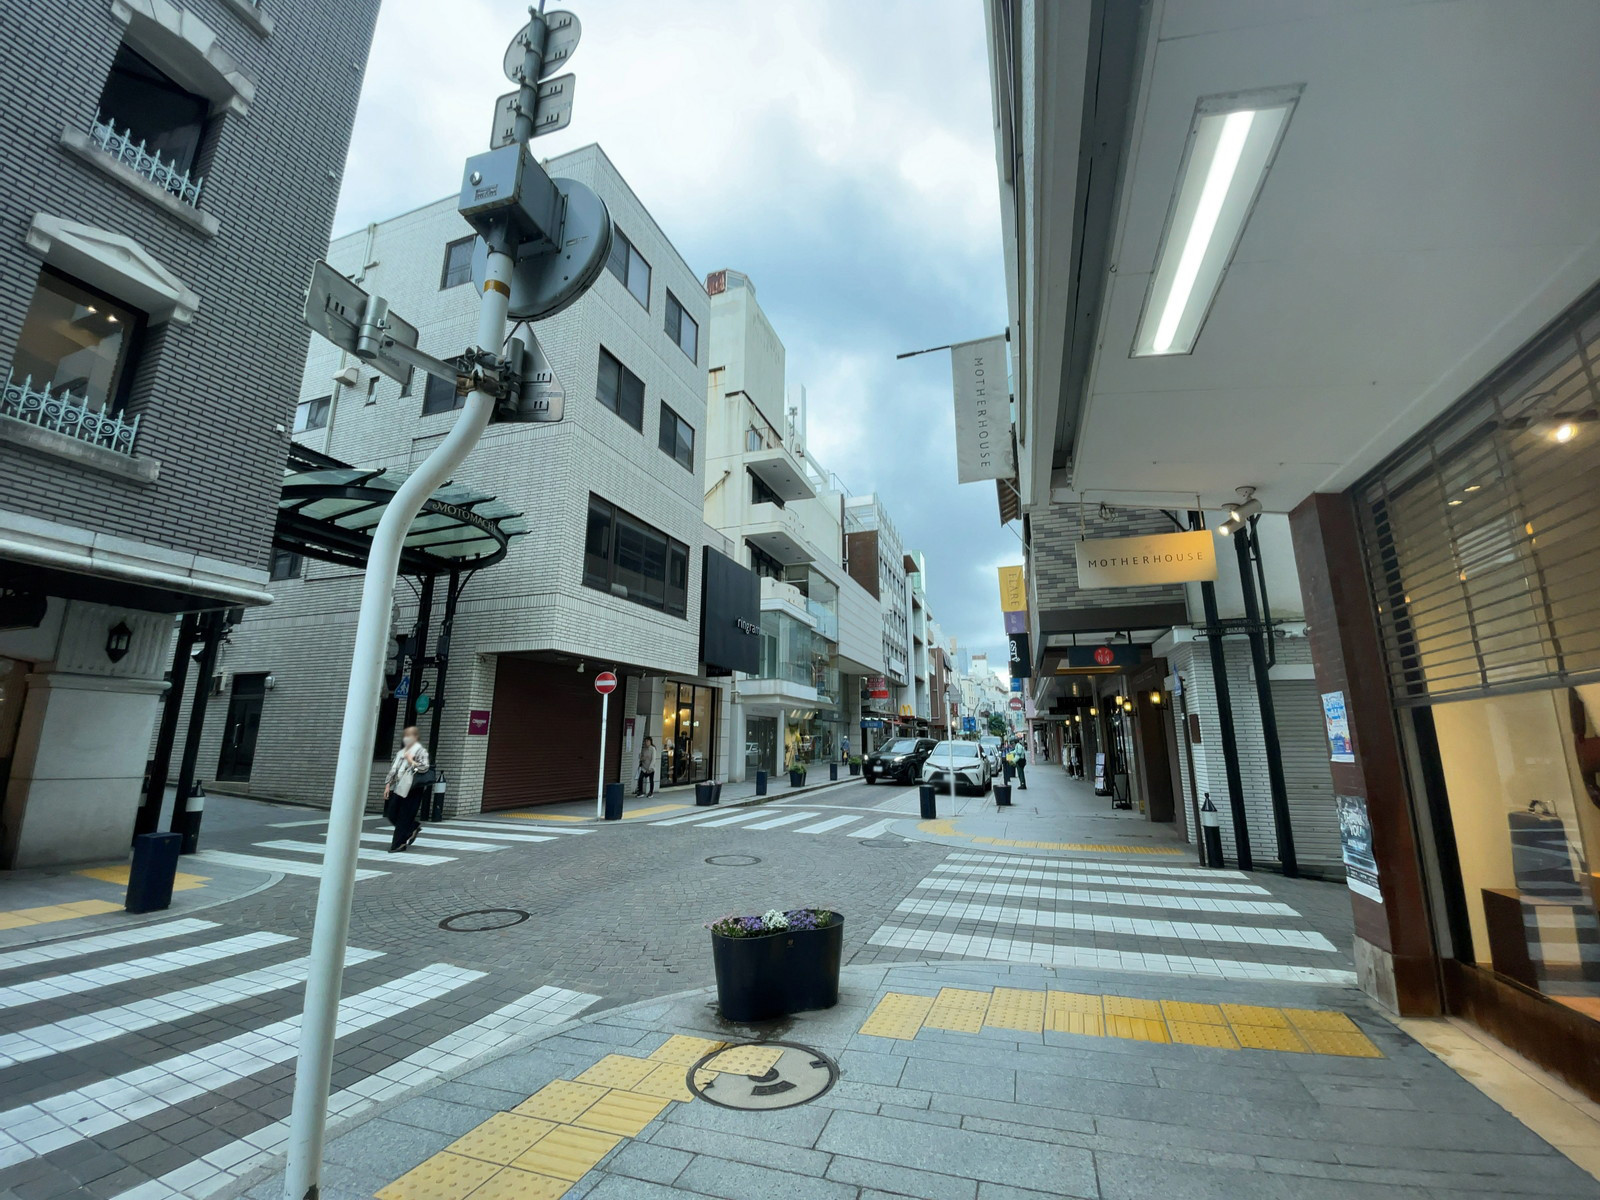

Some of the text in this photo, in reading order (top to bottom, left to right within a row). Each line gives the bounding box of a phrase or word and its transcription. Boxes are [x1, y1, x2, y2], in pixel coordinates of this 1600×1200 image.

[974, 357, 992, 468] MOTHERHOUSE
[432, 502, 496, 533] MOTOMACHI
[1088, 551, 1204, 569] MOTHERHOUSE
[1008, 573, 1020, 607] FLARE
